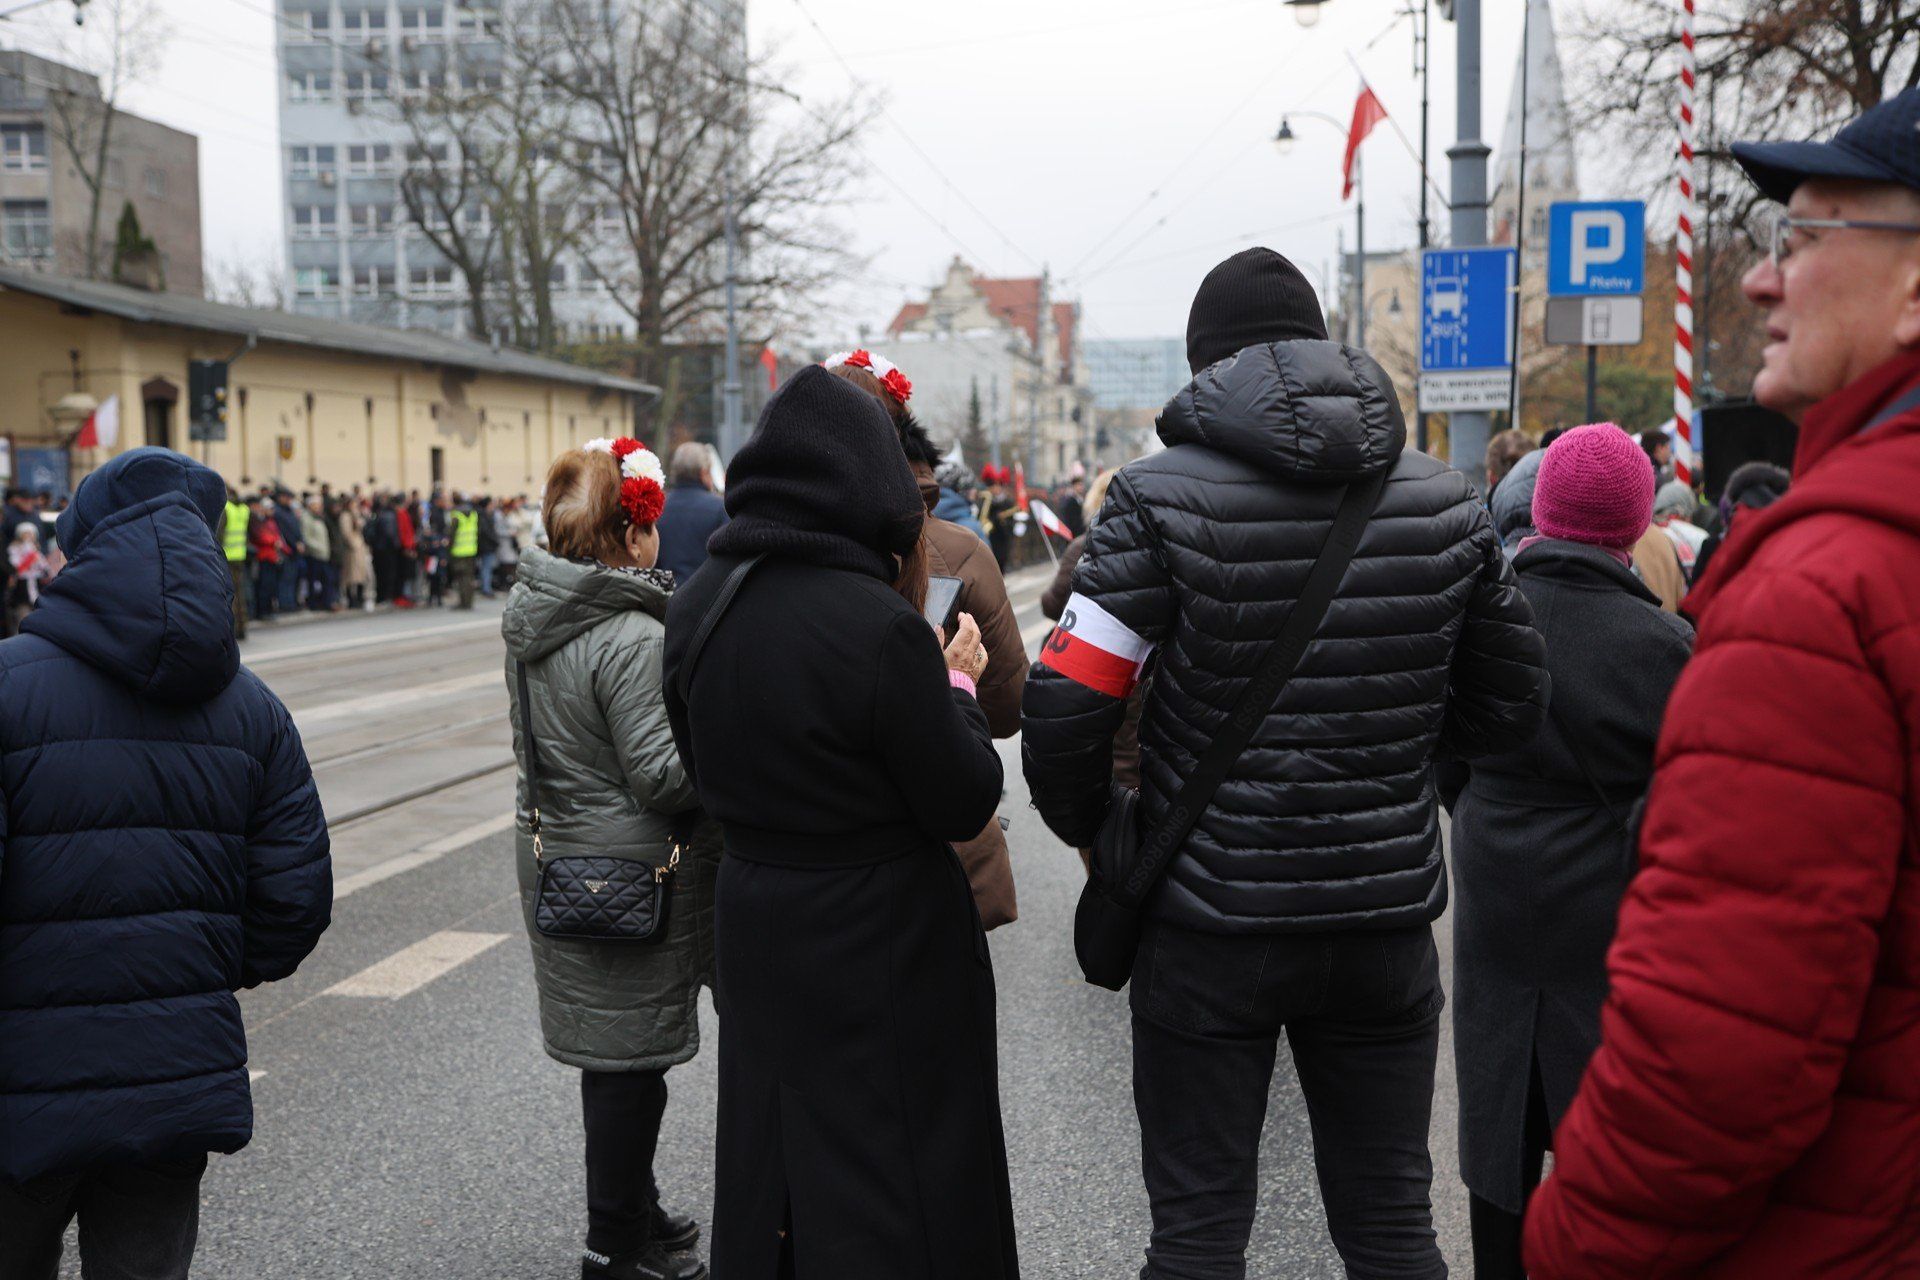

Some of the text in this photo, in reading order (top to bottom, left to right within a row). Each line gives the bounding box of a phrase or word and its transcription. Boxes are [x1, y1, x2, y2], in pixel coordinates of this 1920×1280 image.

[1569, 210, 1626, 285] P
[1432, 321, 1462, 339] BUS
[1125, 805, 1189, 896] GINO ROSSI
